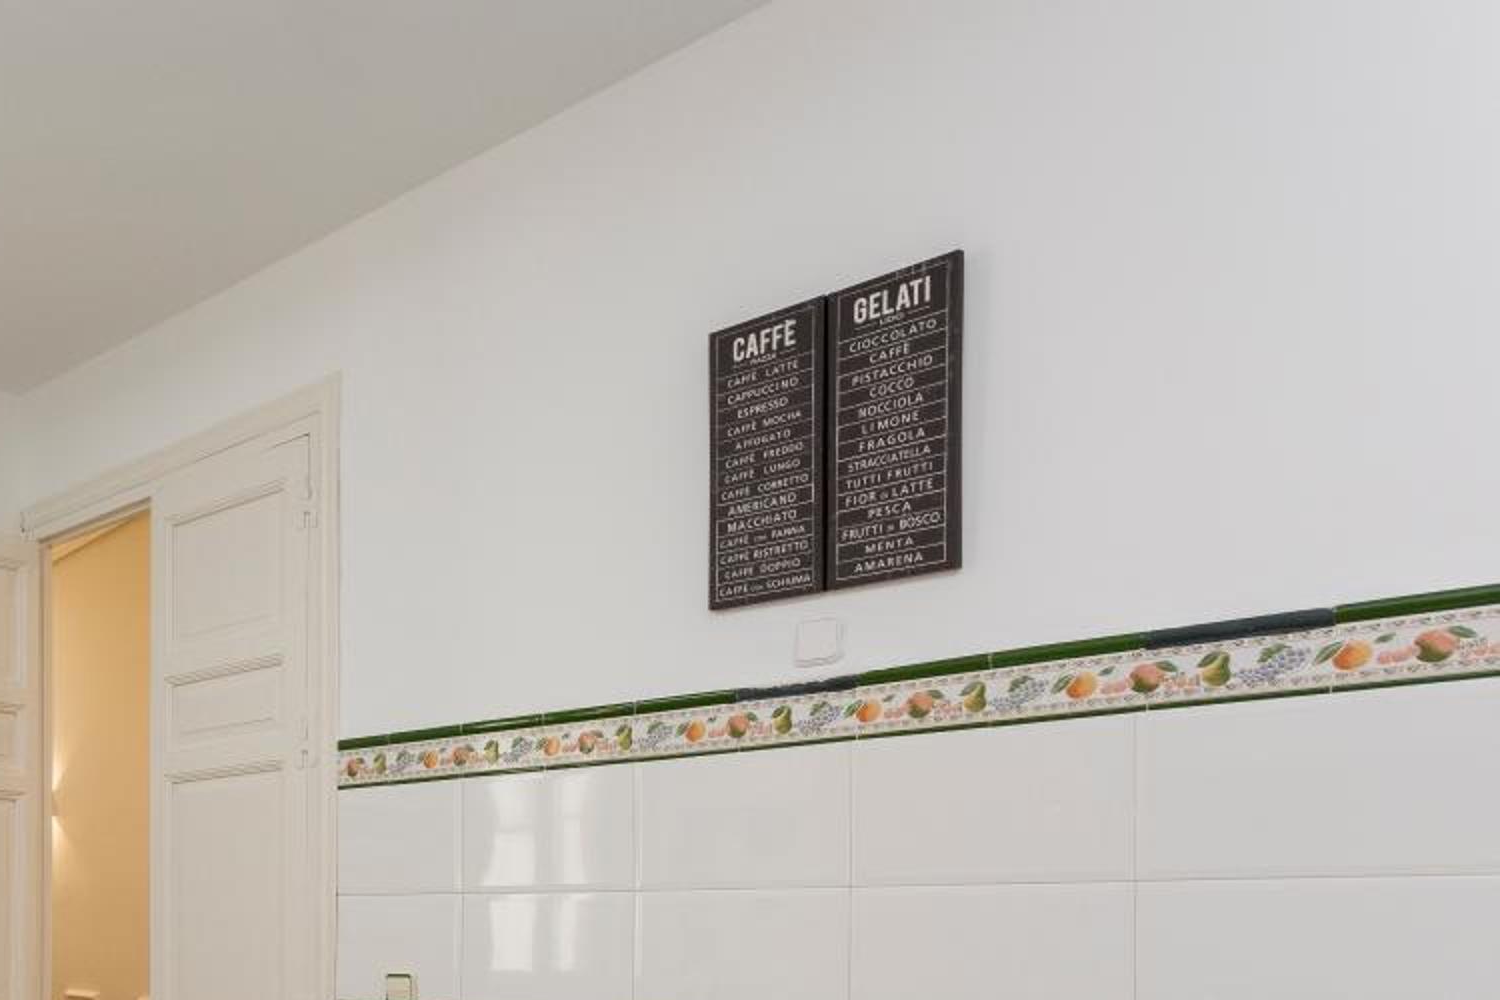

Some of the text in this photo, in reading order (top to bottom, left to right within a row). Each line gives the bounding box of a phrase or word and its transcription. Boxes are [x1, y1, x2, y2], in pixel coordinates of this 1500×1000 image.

[853, 275, 931, 324] GELATI
[733, 319, 796, 362] CAFFE
[849, 318, 937, 353] CIOCCOLATO
[869, 343, 911, 364] CAFFE
[765, 360, 798, 377] LATTE
[852, 354, 933, 386] PISTACCHIO
[869, 375, 915, 398] COCCO
[737, 396, 789, 418] ESPRESSO
[858, 392, 923, 418] NOCCIOLA
[861, 411, 919, 435] LIMONE
[860, 427, 925, 452] FRAGOLA
[848, 445, 931, 473] STRACCIATELLA
[846, 462, 933, 489] TUTTI FRUTTI
[892, 478, 933, 496] LATTE
[727, 492, 797, 516] AMERICANO
[868, 501, 912, 518] PESCA
[727, 510, 797, 533] MACCHIATO
[841, 523, 883, 541] FRUTTI
[899, 512, 940, 530] BOSCO
[865, 536, 914, 553] MENTA
[854, 551, 923, 573] AMARENA
